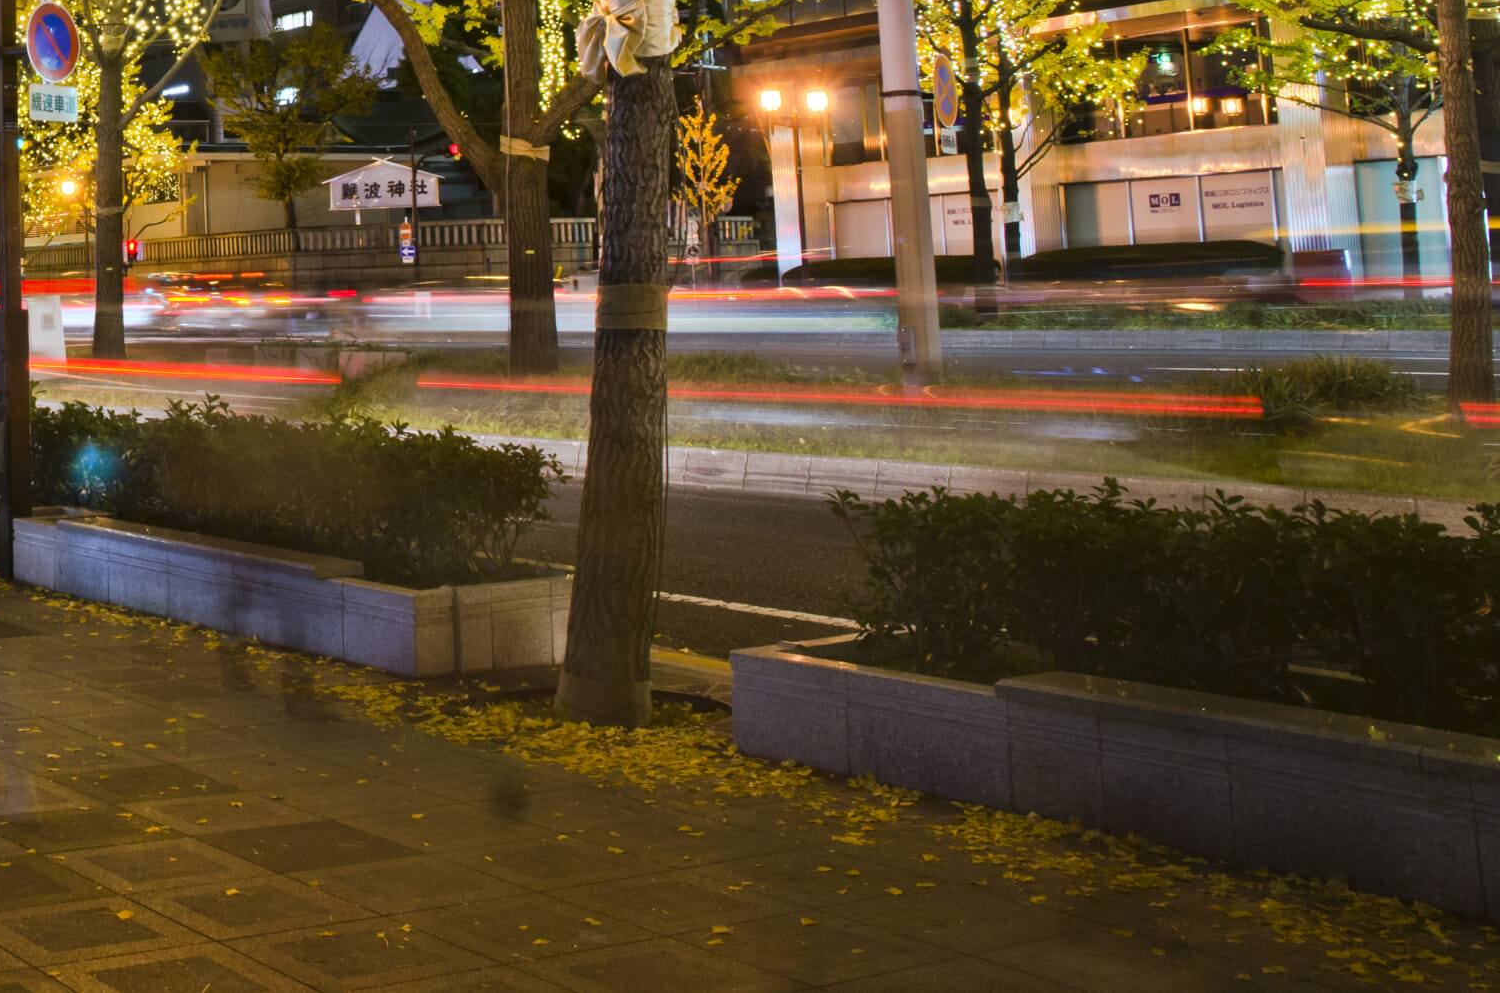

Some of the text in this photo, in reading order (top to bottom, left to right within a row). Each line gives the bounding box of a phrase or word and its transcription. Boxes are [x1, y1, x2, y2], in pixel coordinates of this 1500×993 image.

[341, 179, 429, 200] 難波神社
[1149, 193, 1181, 208] MOL
